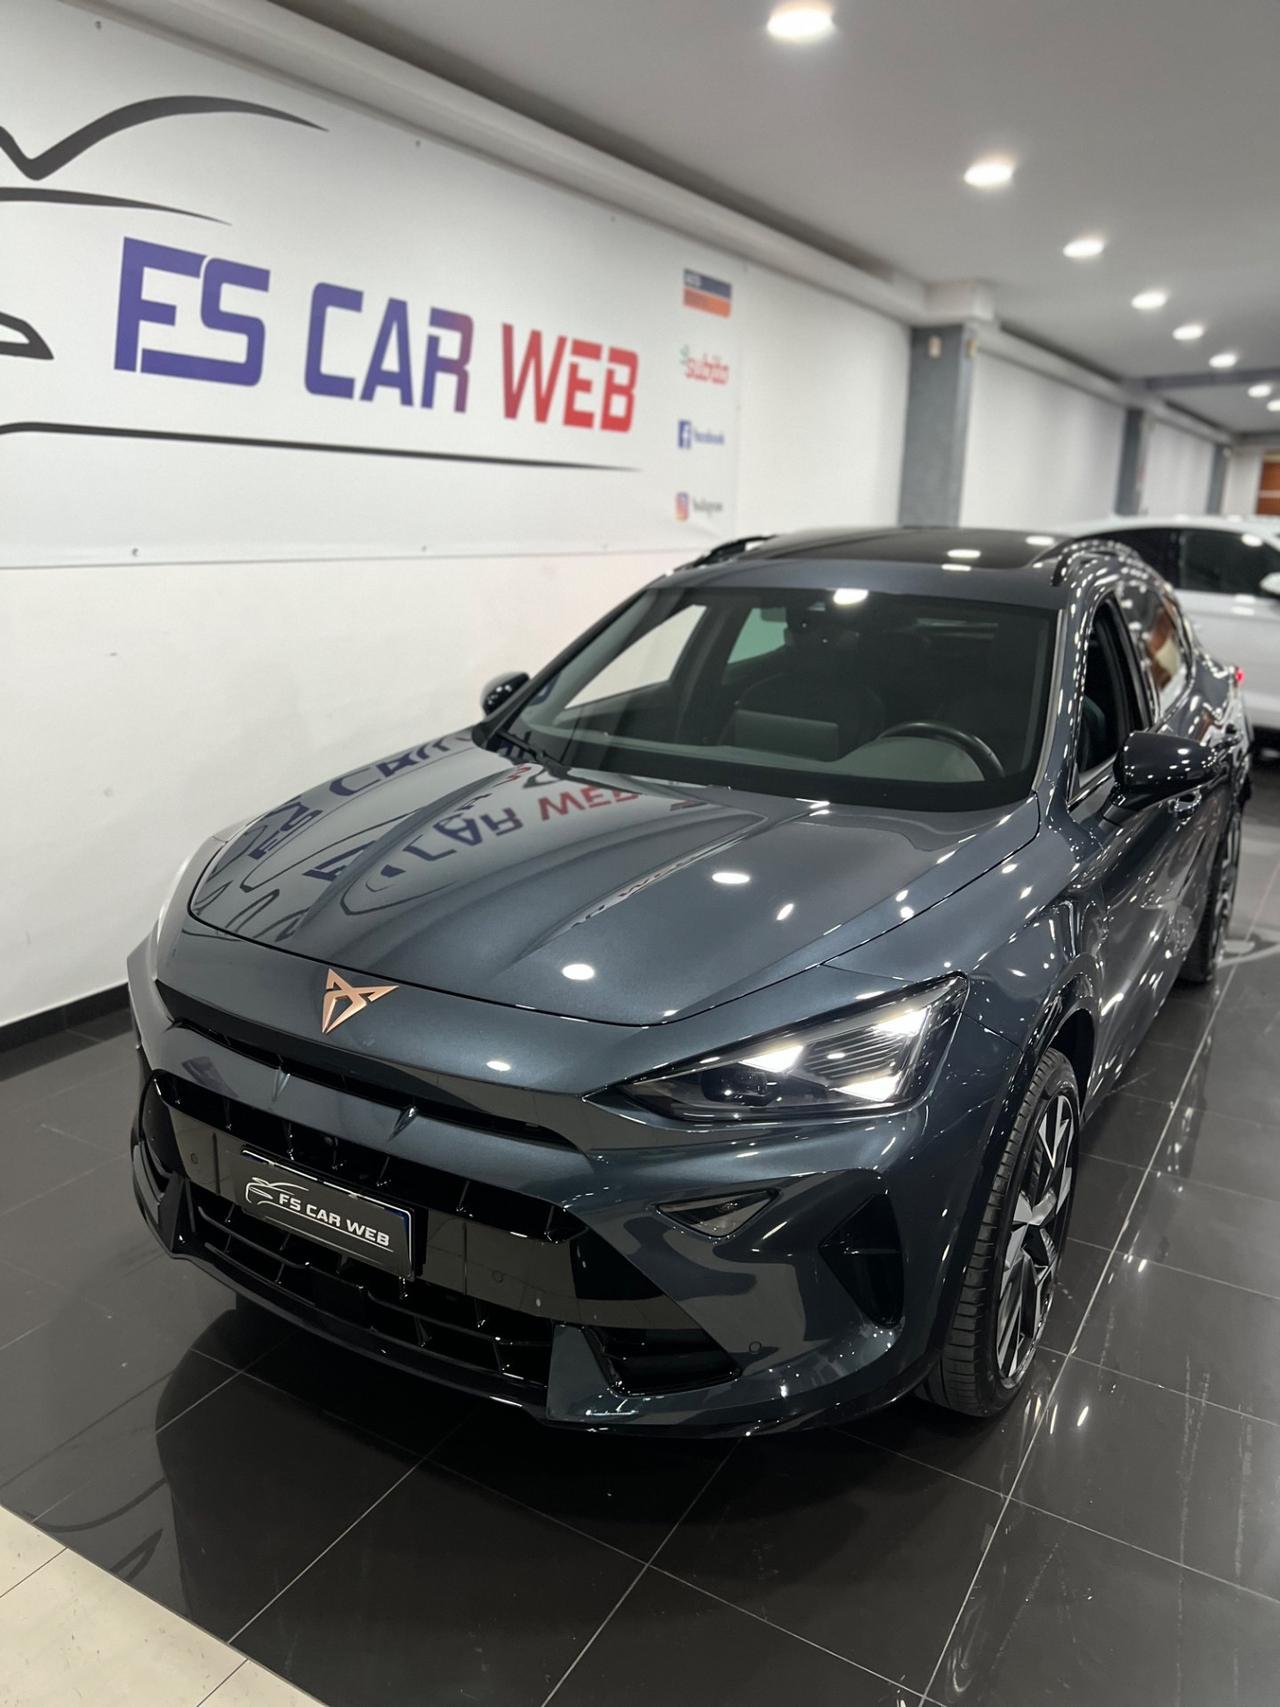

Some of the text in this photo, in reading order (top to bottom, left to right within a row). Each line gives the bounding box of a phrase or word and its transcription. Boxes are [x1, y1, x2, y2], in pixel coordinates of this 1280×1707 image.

[114, 236, 639, 432] FS CAR WEB
[279, 1193, 390, 1246] FS CAR WEB
